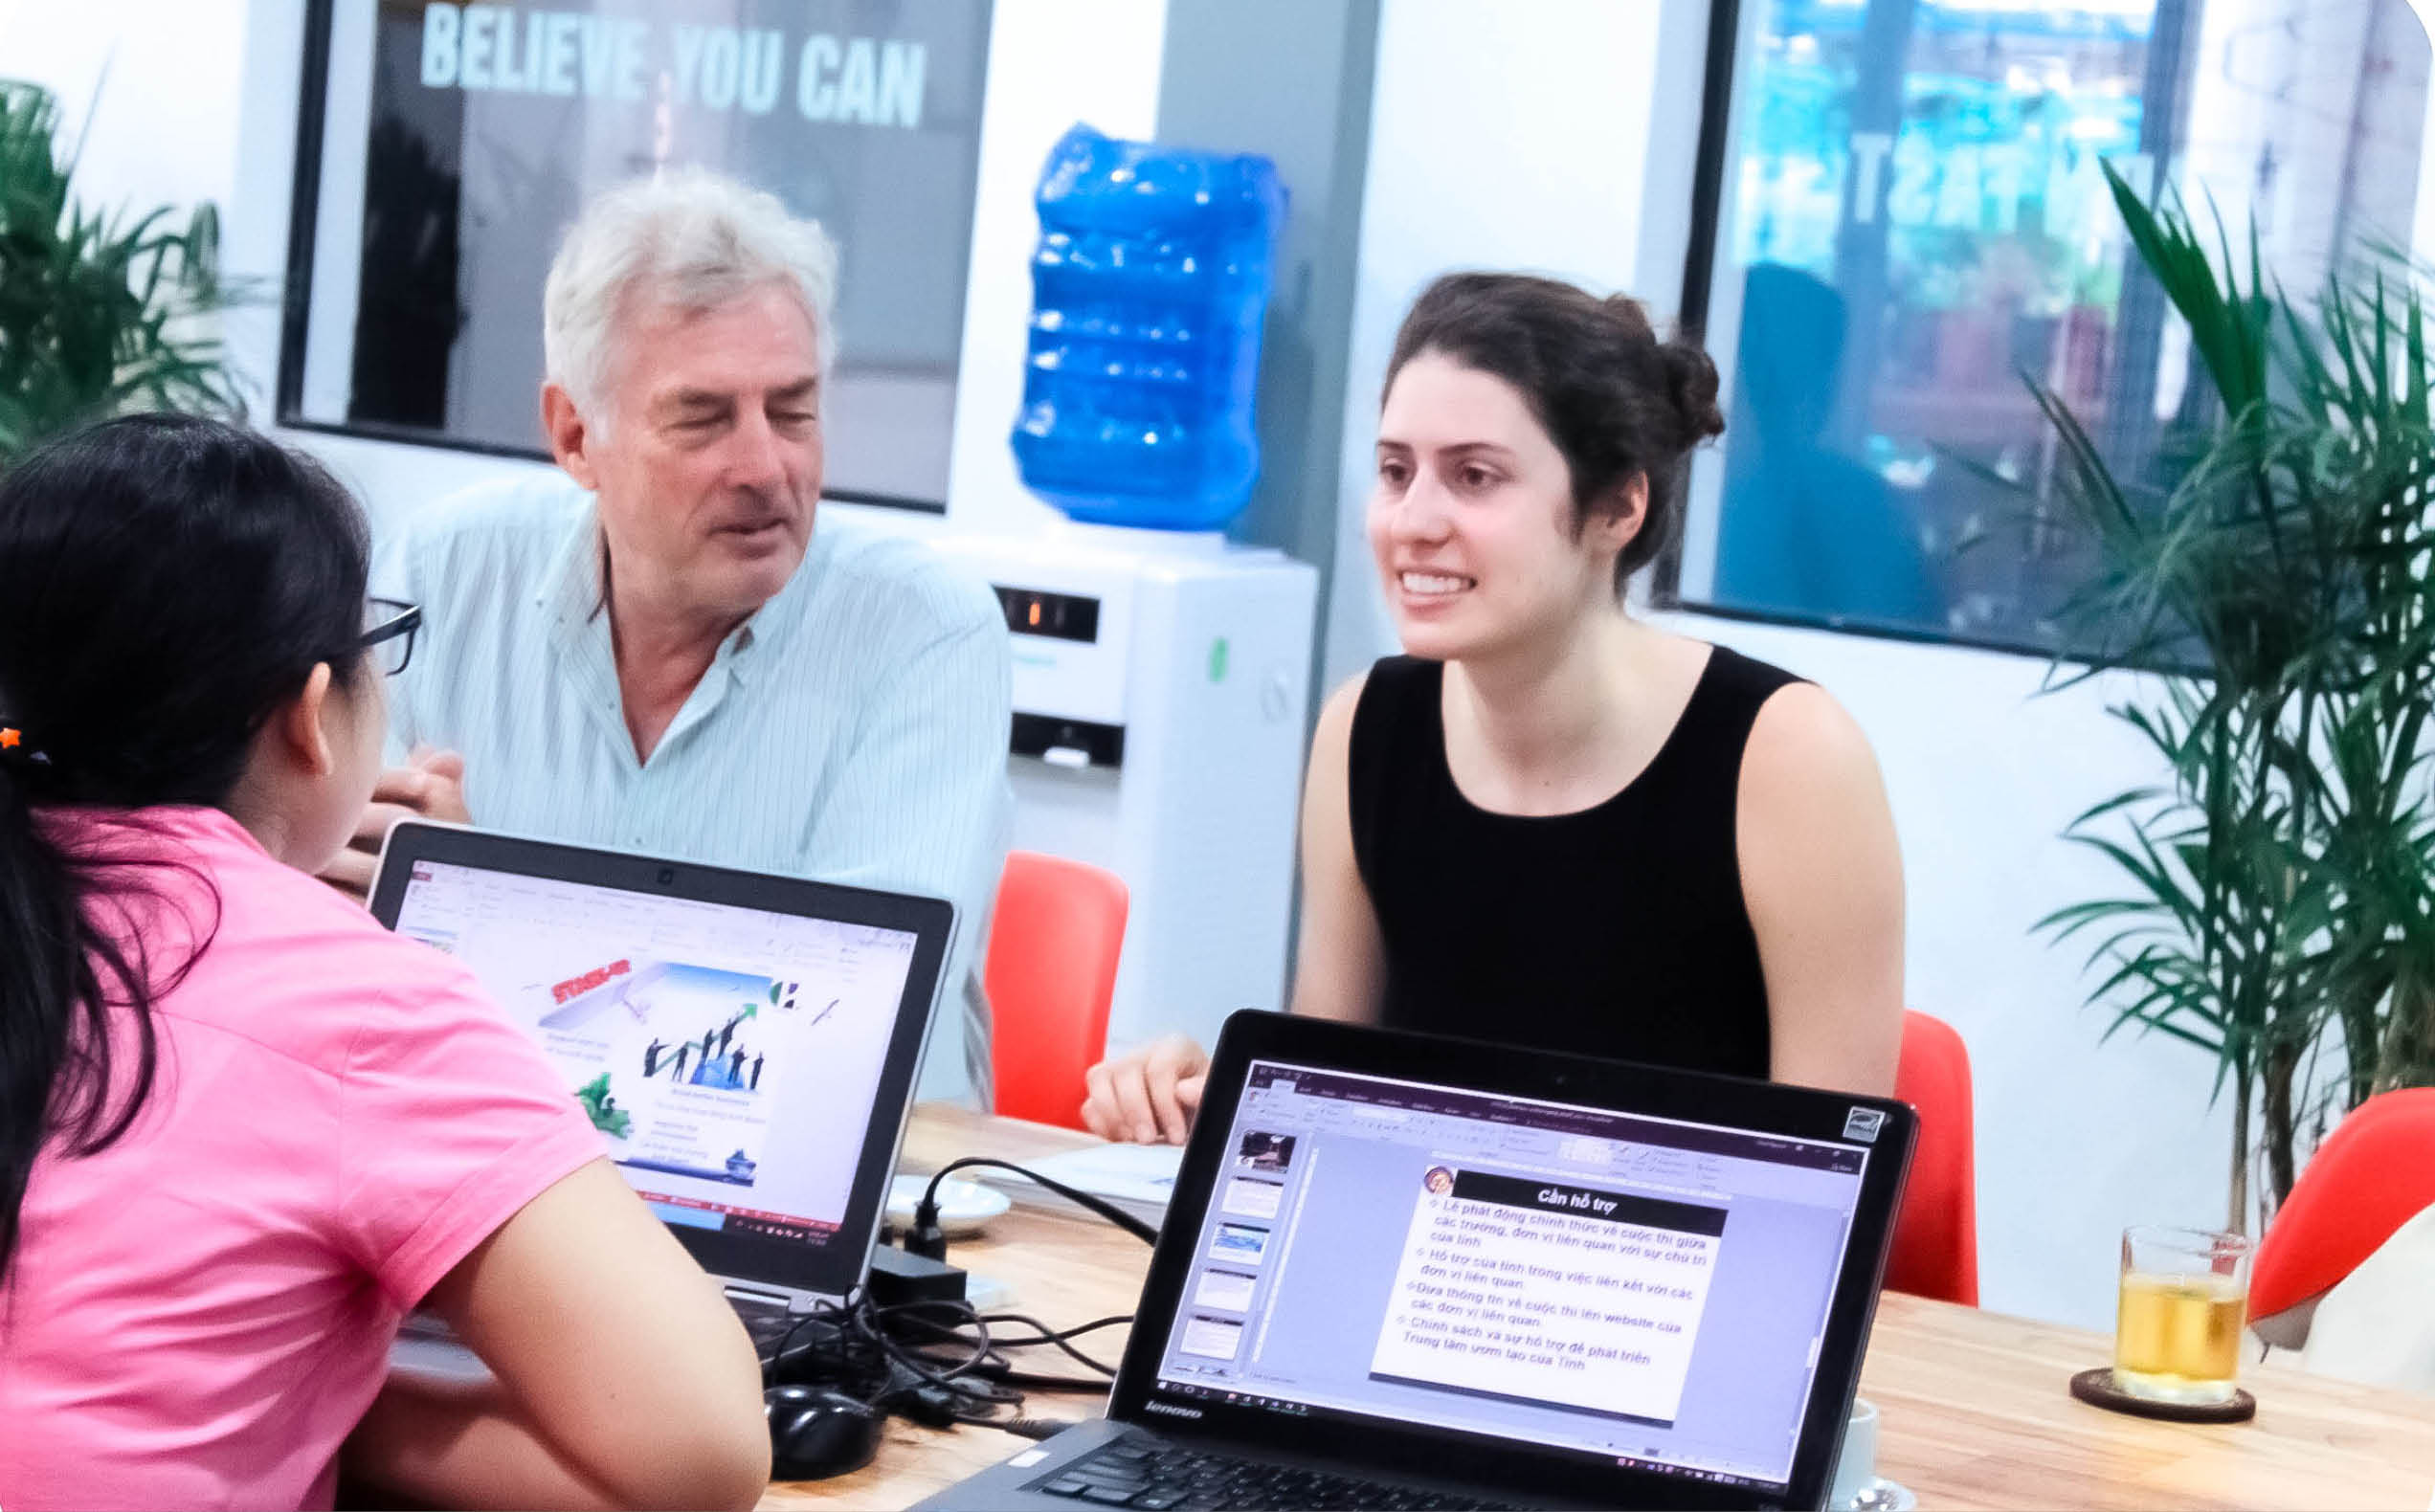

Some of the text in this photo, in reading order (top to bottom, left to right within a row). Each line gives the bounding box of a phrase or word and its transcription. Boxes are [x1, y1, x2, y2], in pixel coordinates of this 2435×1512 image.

[421, 3, 928, 128] BELIEVE YOU CAN
